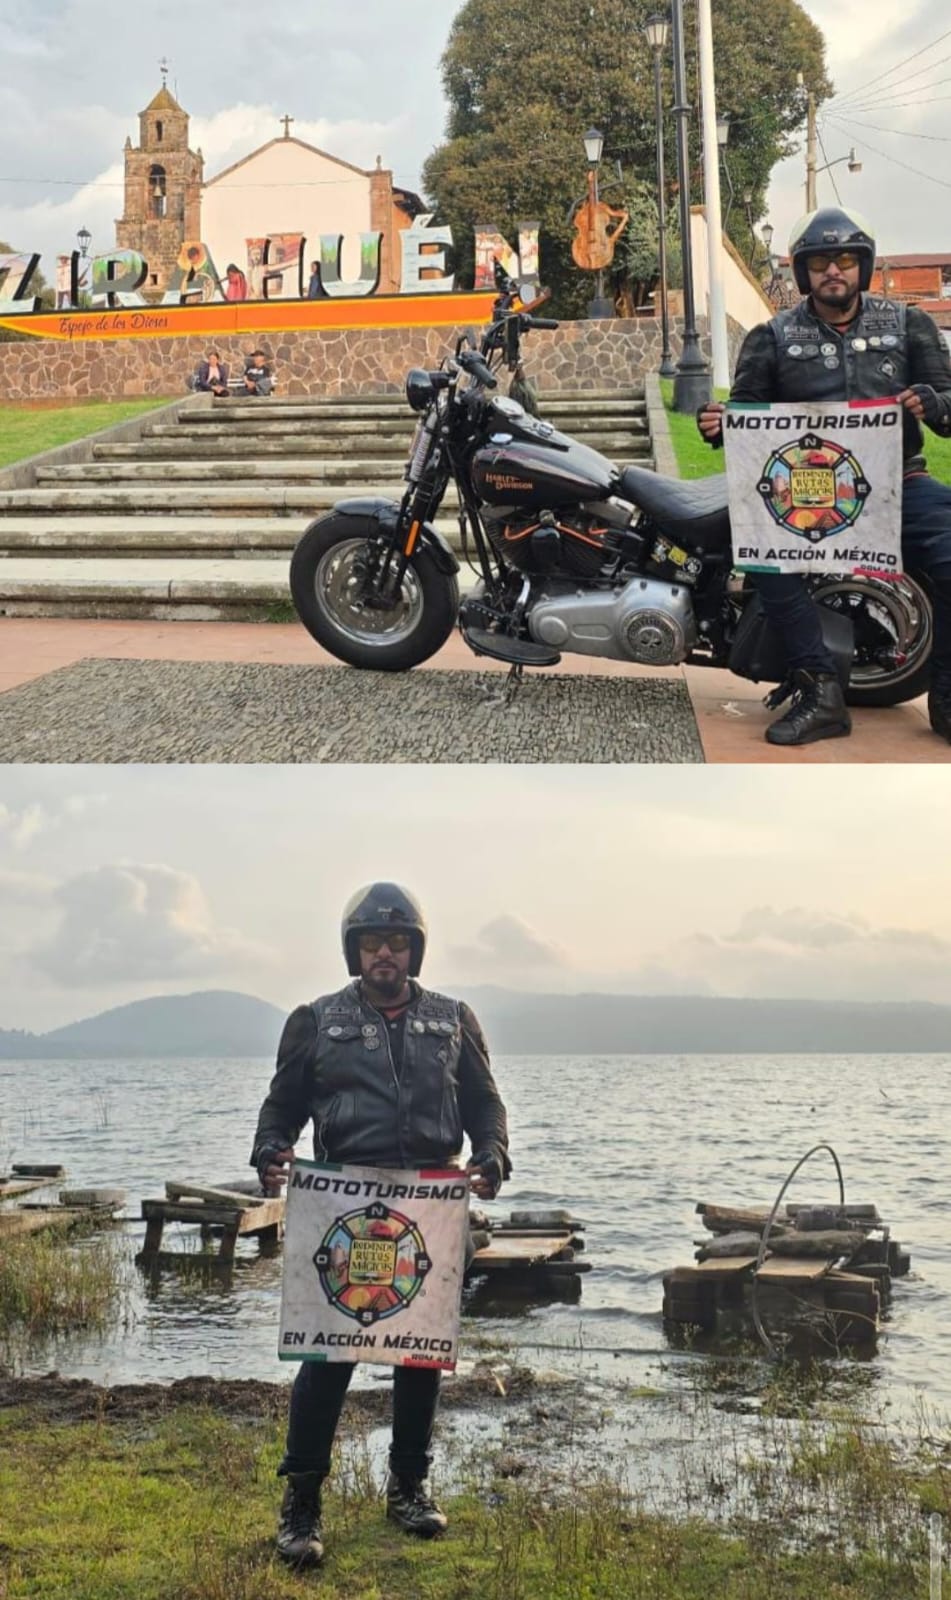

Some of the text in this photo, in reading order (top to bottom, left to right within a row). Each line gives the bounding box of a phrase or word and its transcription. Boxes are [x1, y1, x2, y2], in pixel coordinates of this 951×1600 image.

[59, 313, 168, 339] Espejo de los Dioses
[726, 411, 898, 430] MOTOTURISMO
[804, 438, 817, 446] N
[810, 530, 821, 538] S
[738, 545, 897, 566] EN ACCIÓN MÉXICO
[291, 1171, 466, 1200] MOTOTURISMO
[371, 1207, 384, 1215] N
[418, 1260, 428, 1269] E
[363, 1312, 373, 1321] S
[283, 1329, 452, 1352] EN ACCIÓN MÉXICO
